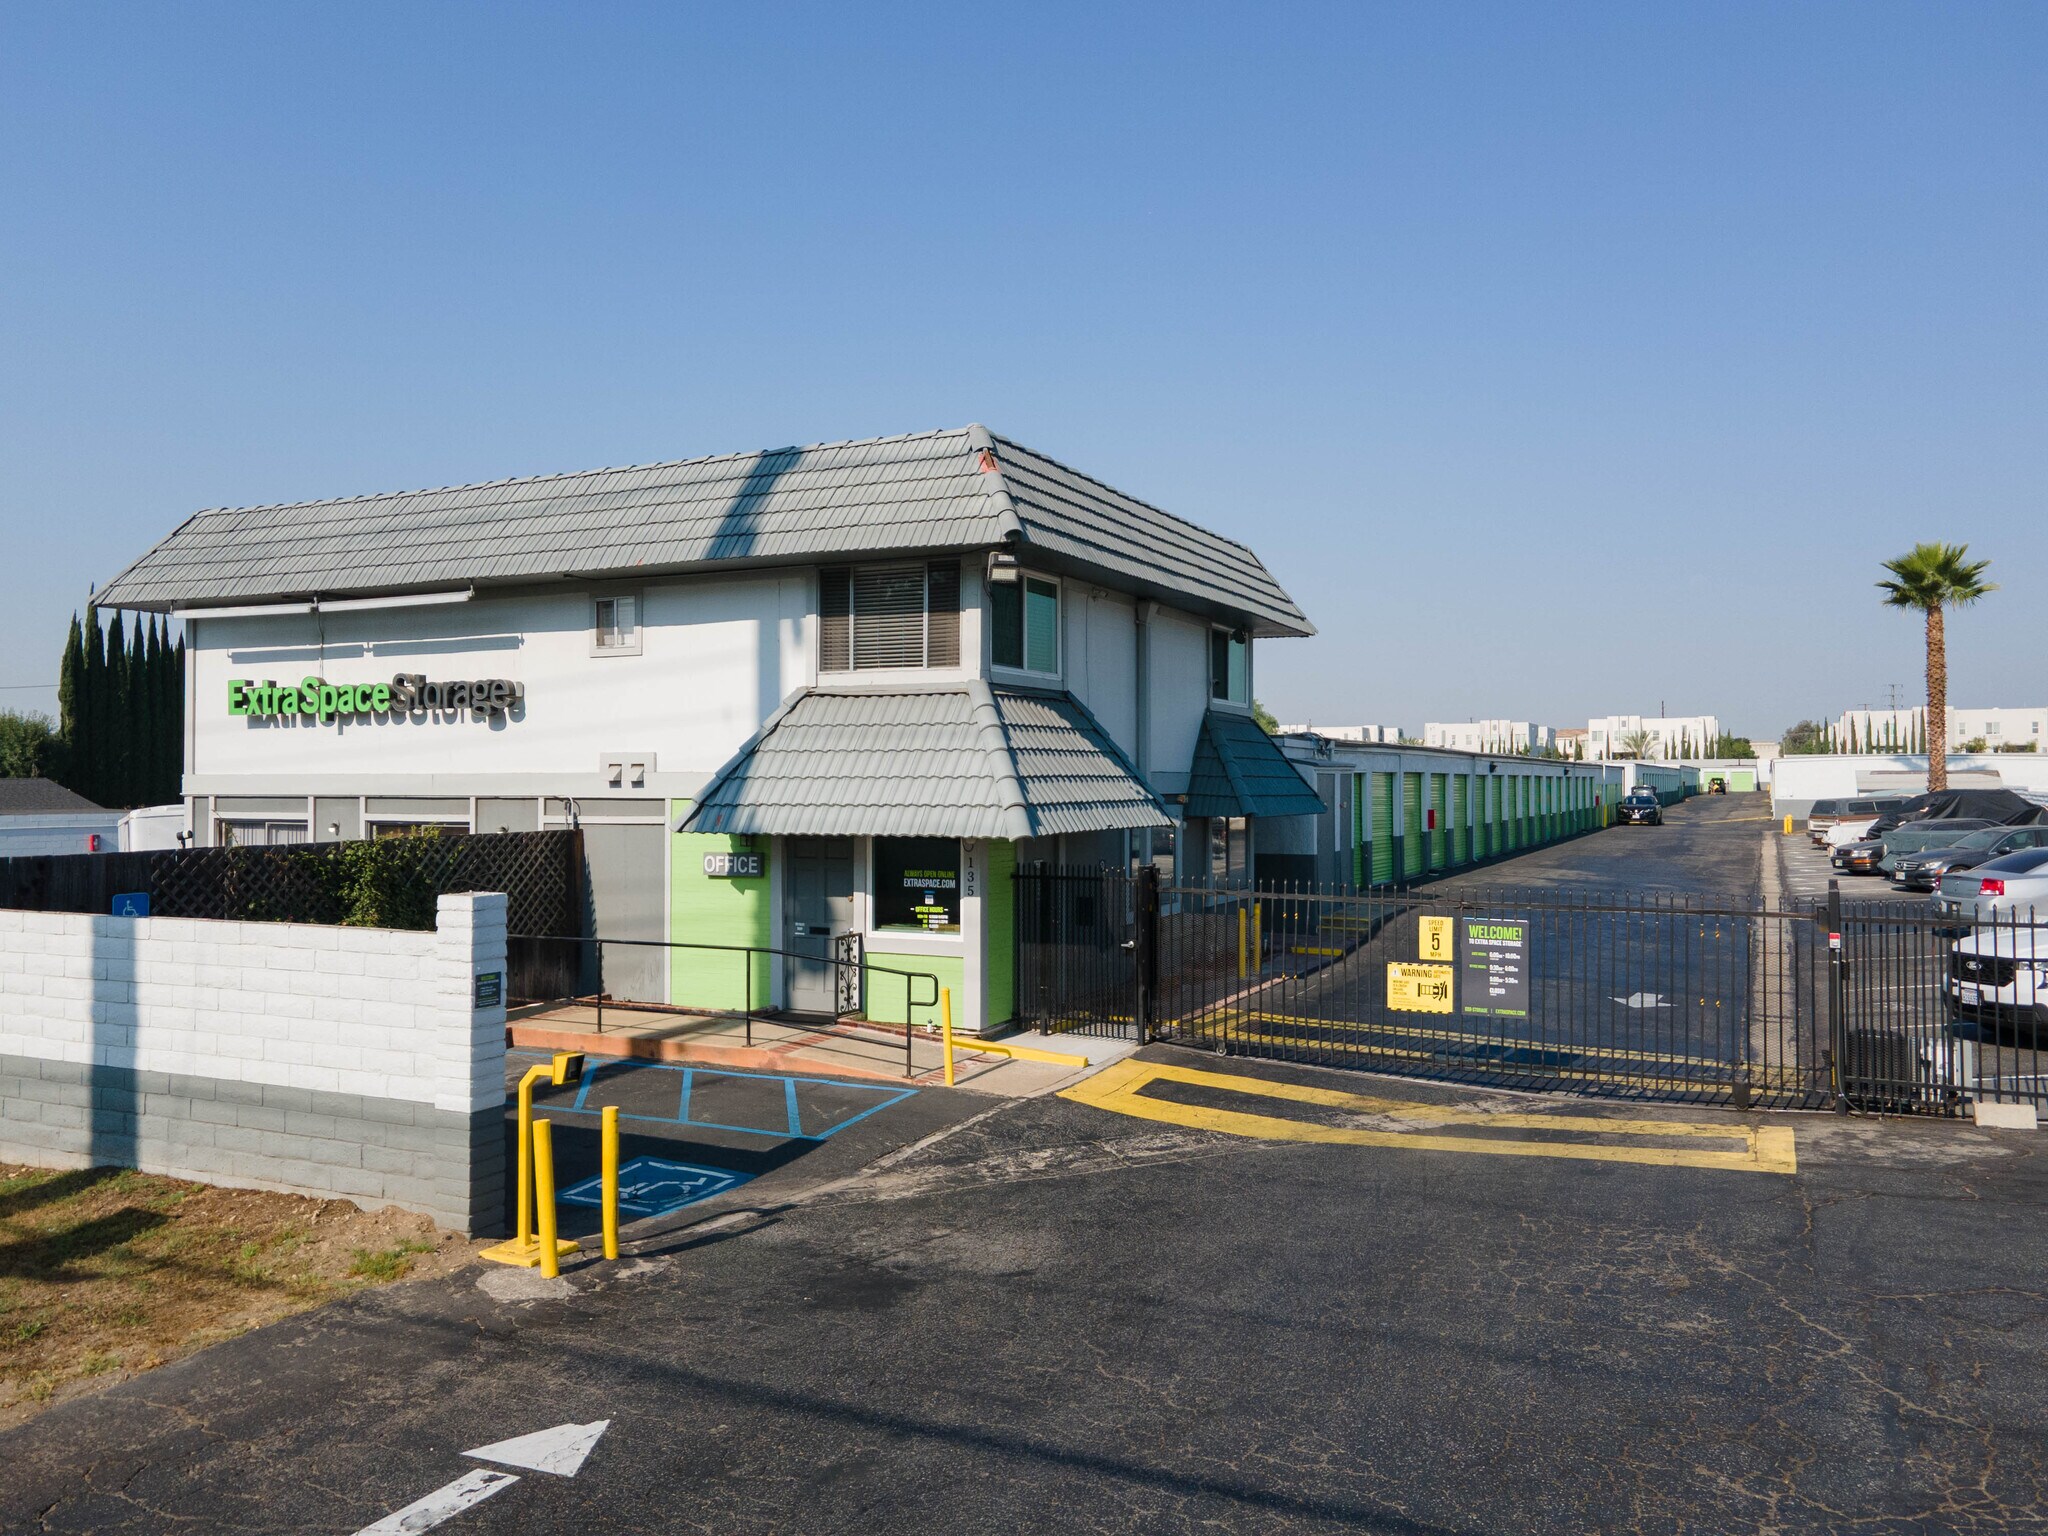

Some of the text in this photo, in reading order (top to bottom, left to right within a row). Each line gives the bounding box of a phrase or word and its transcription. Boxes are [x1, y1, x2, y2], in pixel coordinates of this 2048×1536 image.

[392, 673, 512, 717] Storage
[704, 855, 758, 873] OFFICE
[924, 870, 937, 878] OPEN
[904, 878, 956, 888] EXTRASPACE.COM
[1468, 925, 1522, 940] WELCOME!
[1432, 933, 1440, 950] 5
[1401, 968, 1433, 978] WARNING
